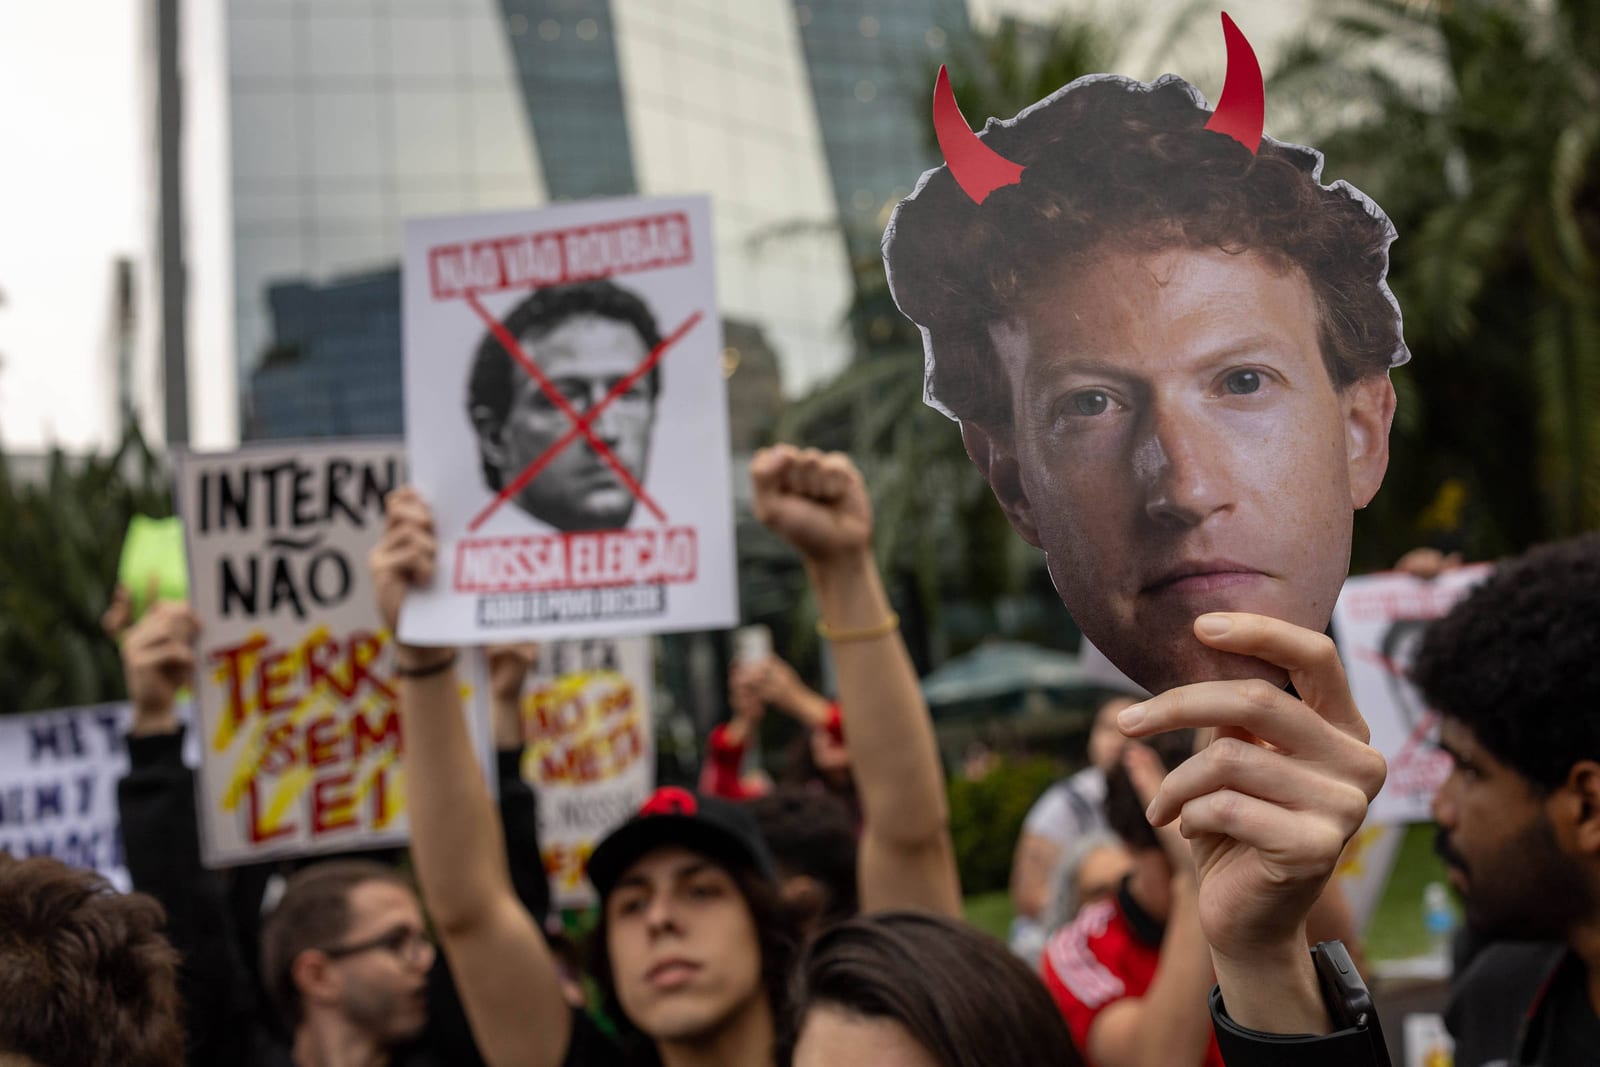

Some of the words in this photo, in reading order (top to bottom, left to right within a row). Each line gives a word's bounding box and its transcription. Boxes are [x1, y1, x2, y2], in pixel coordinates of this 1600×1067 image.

[435, 241, 500, 292] NÃO
[505, 233, 562, 286] VÃO
[566, 217, 688, 280] ROUBAR
[219, 533, 353, 621] NÃO
[460, 538, 566, 586] NOSSA
[570, 530, 693, 584] ELEIÇÃO
[262, 707, 405, 775] SEM
[247, 767, 388, 845] LEI
